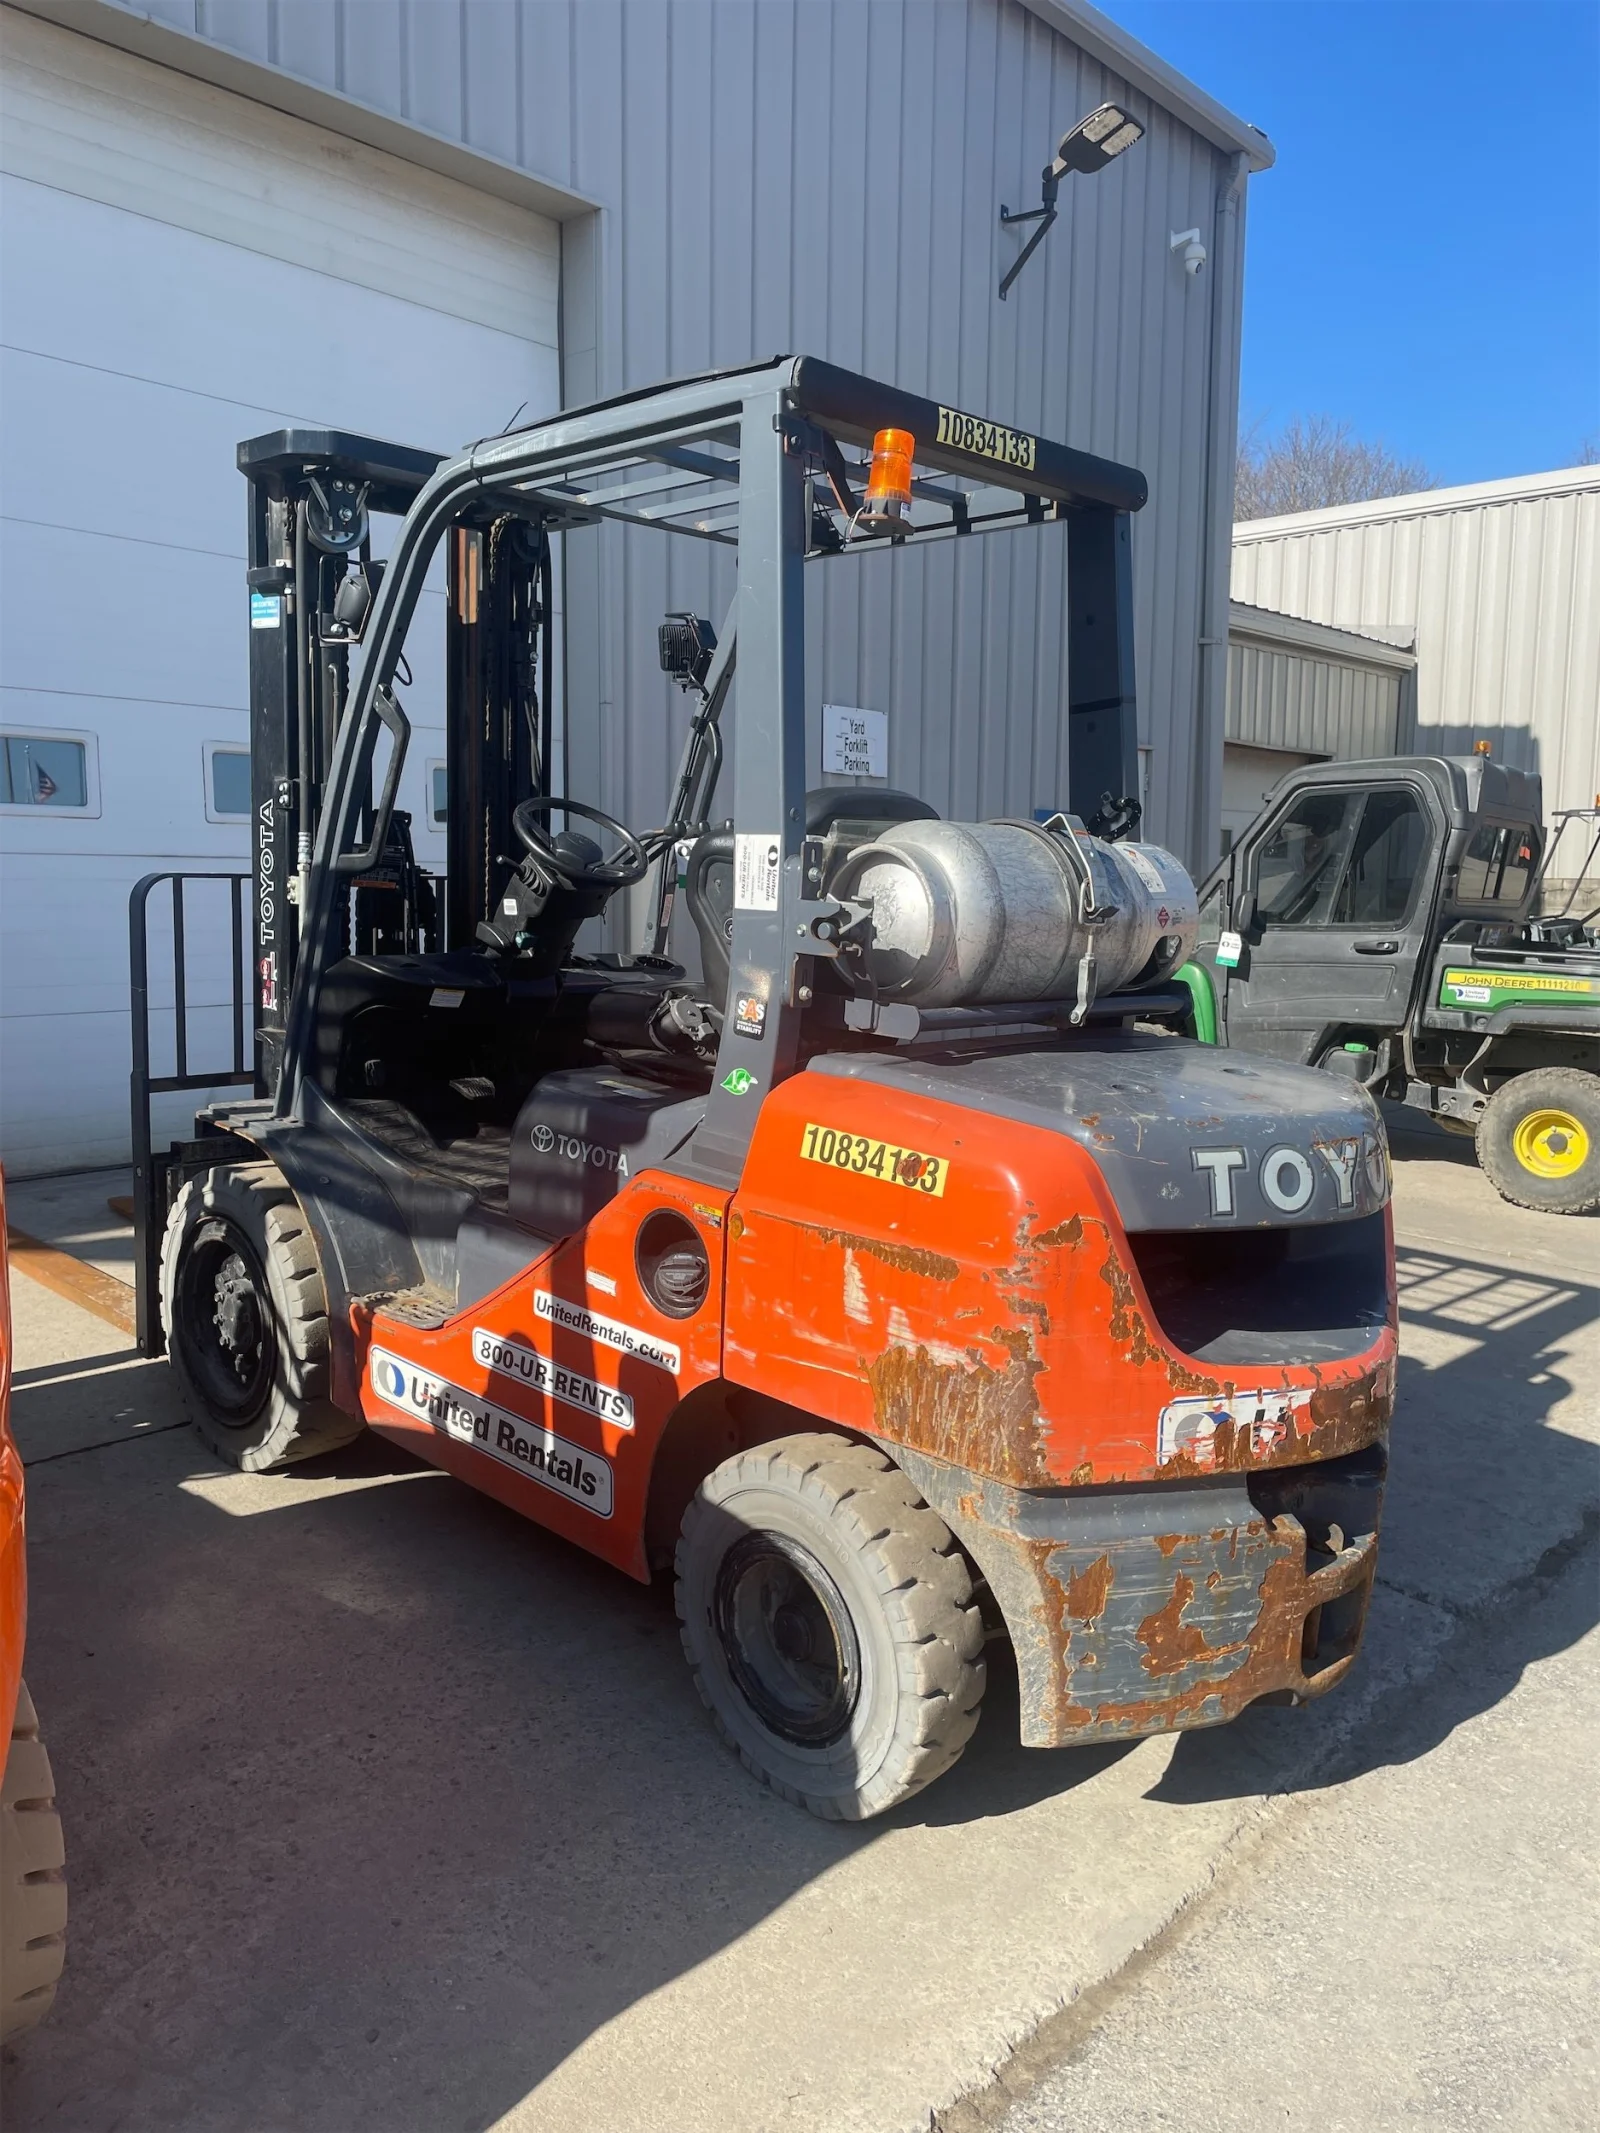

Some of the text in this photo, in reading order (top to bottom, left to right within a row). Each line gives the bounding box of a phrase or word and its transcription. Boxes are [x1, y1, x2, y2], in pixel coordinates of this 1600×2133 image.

[941, 410, 1031, 468] 10834133
[844, 737, 868, 754] Forklift
[849, 718, 865, 735] Yard
[844, 755, 870, 774] Parking
[260, 798, 275, 945] TOYOTA
[1460, 975, 1493, 986] JOHN
[1494, 976, 1535, 988] DEERE
[737, 998, 765, 1023] SAS
[557, 1133, 630, 1177] TOYOTA
[536, 1294, 677, 1368] UnitedRentals.com
[480, 1339, 625, 1419] 800-UR-RENTS
[411, 1376, 598, 1497] United Rentals
